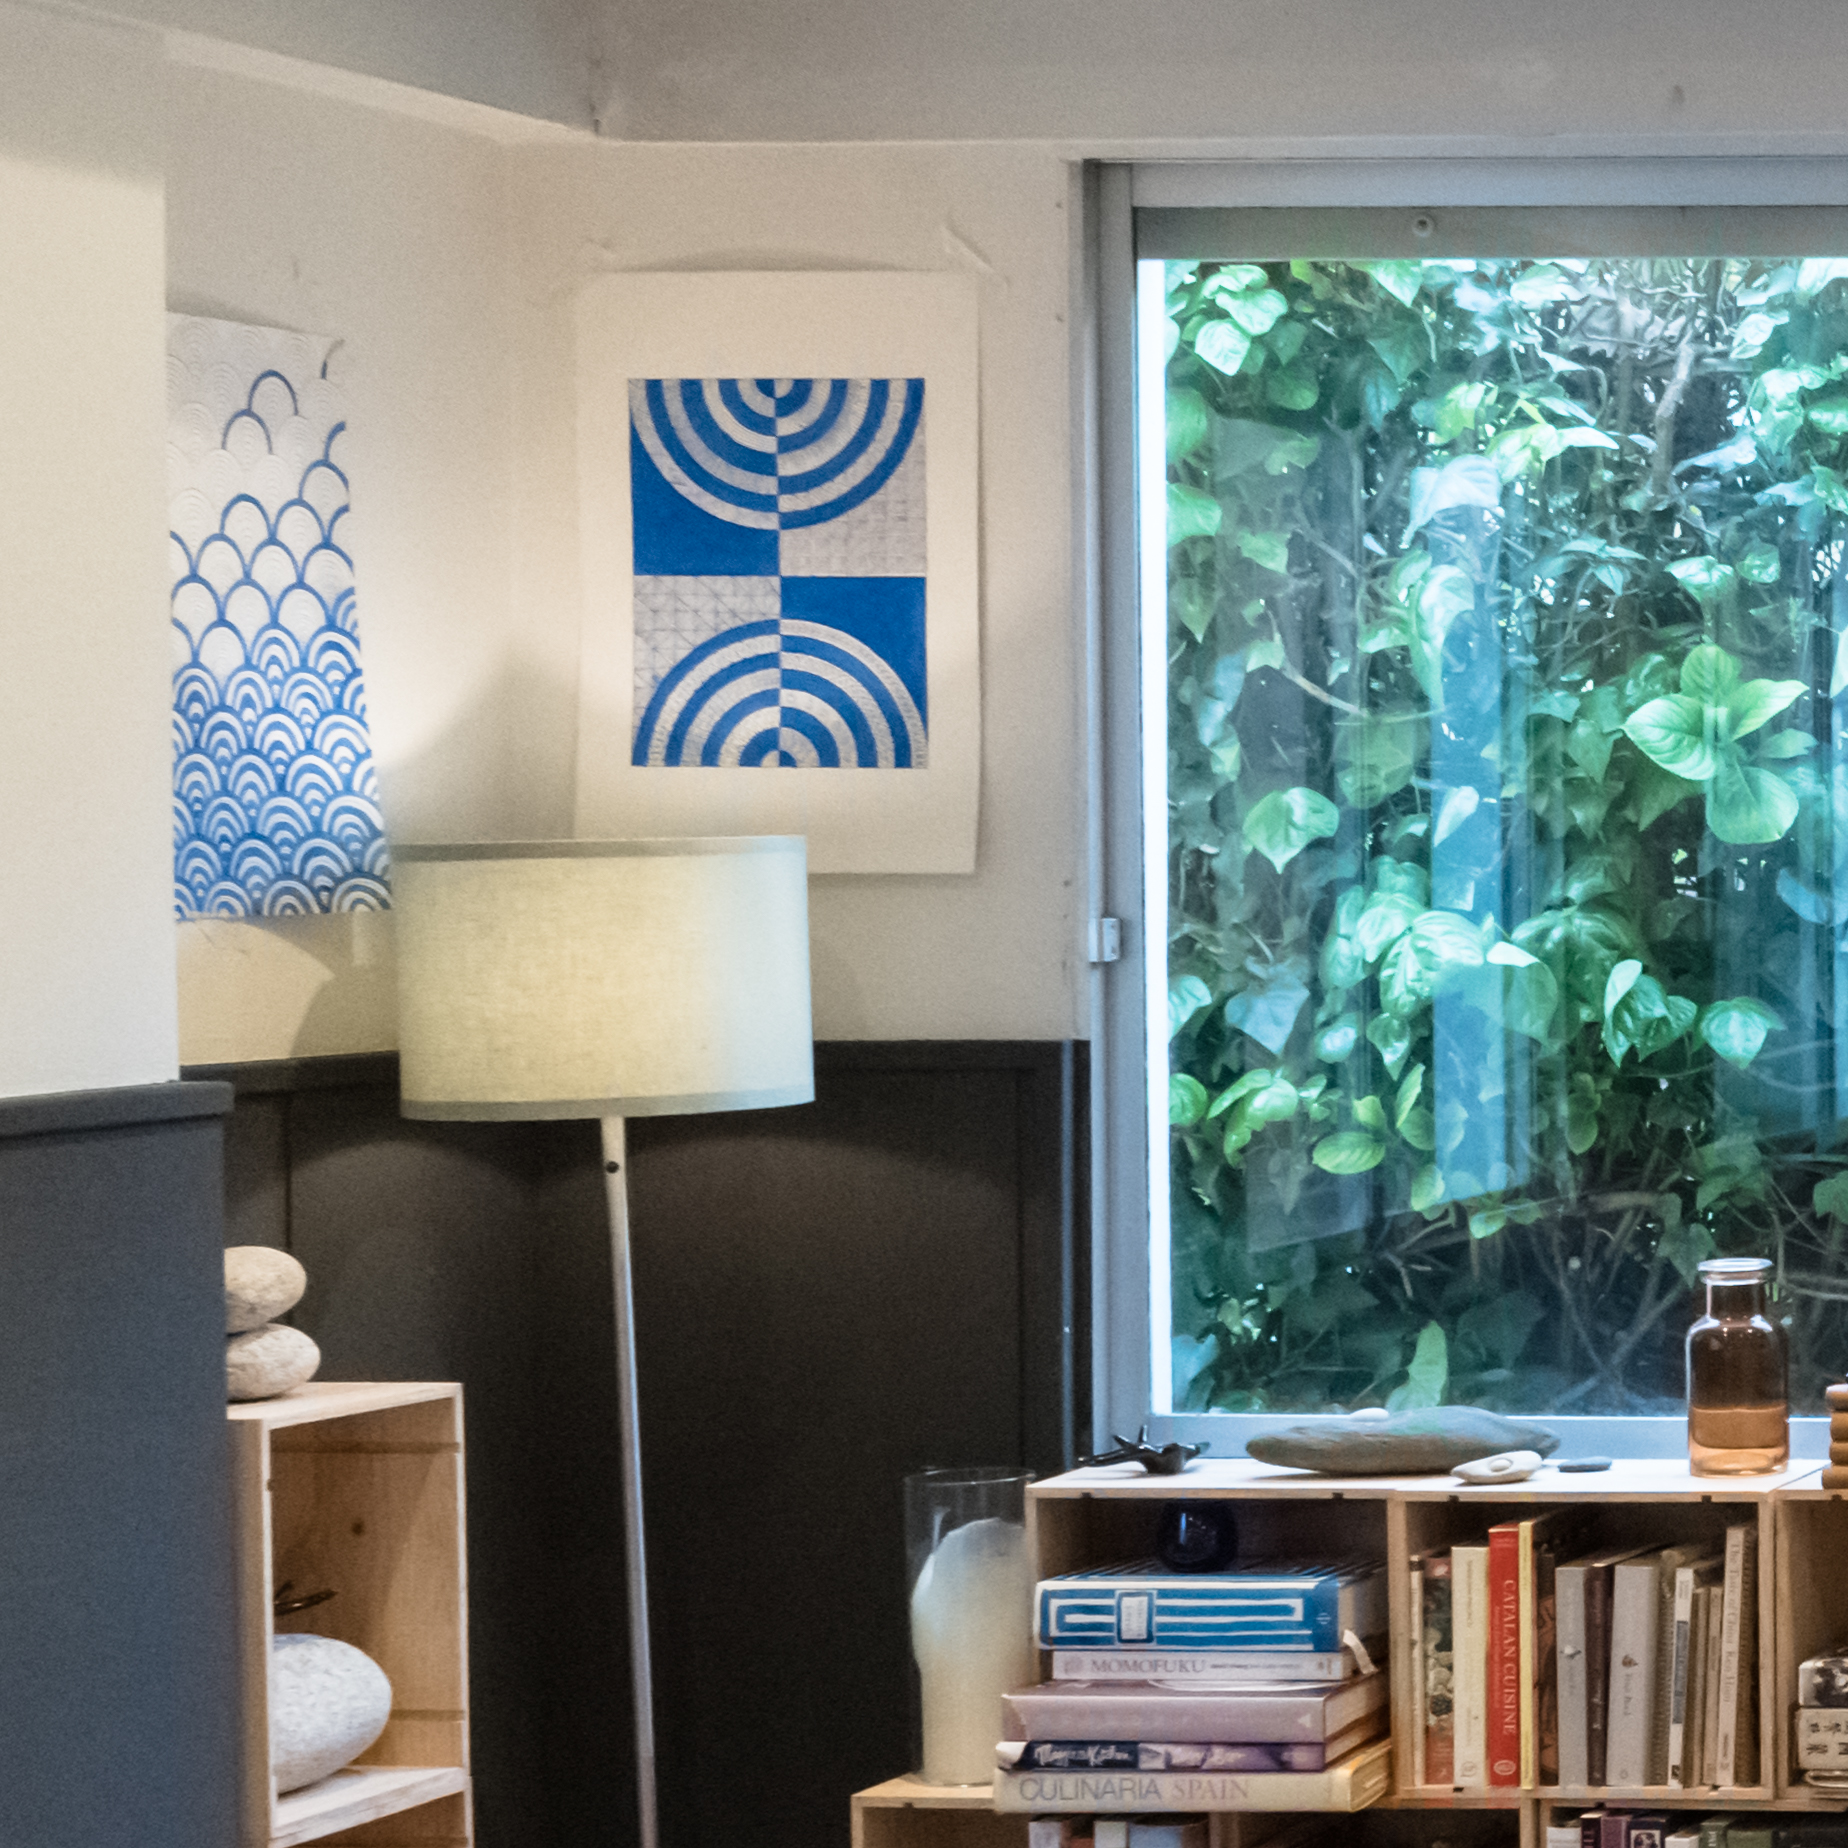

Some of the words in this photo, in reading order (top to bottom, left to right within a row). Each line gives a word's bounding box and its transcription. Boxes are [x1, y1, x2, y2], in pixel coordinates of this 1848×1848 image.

[1731, 1543, 1741, 1566] The
[1729, 1568, 1740, 1596] Taste
[1728, 1598, 1739, 1612] of
[1502, 1578, 1517, 1658] CATALAN
[1726, 1613, 1738, 1644] China
[1091, 1659, 1205, 1674] MOMOFUKU
[1725, 1650, 1735, 1673] Ken
[1502, 1662, 1517, 1736] CUISINE
[1019, 1777, 1162, 1802] CULINARIA
[1173, 1777, 1251, 1801] SPAIN
